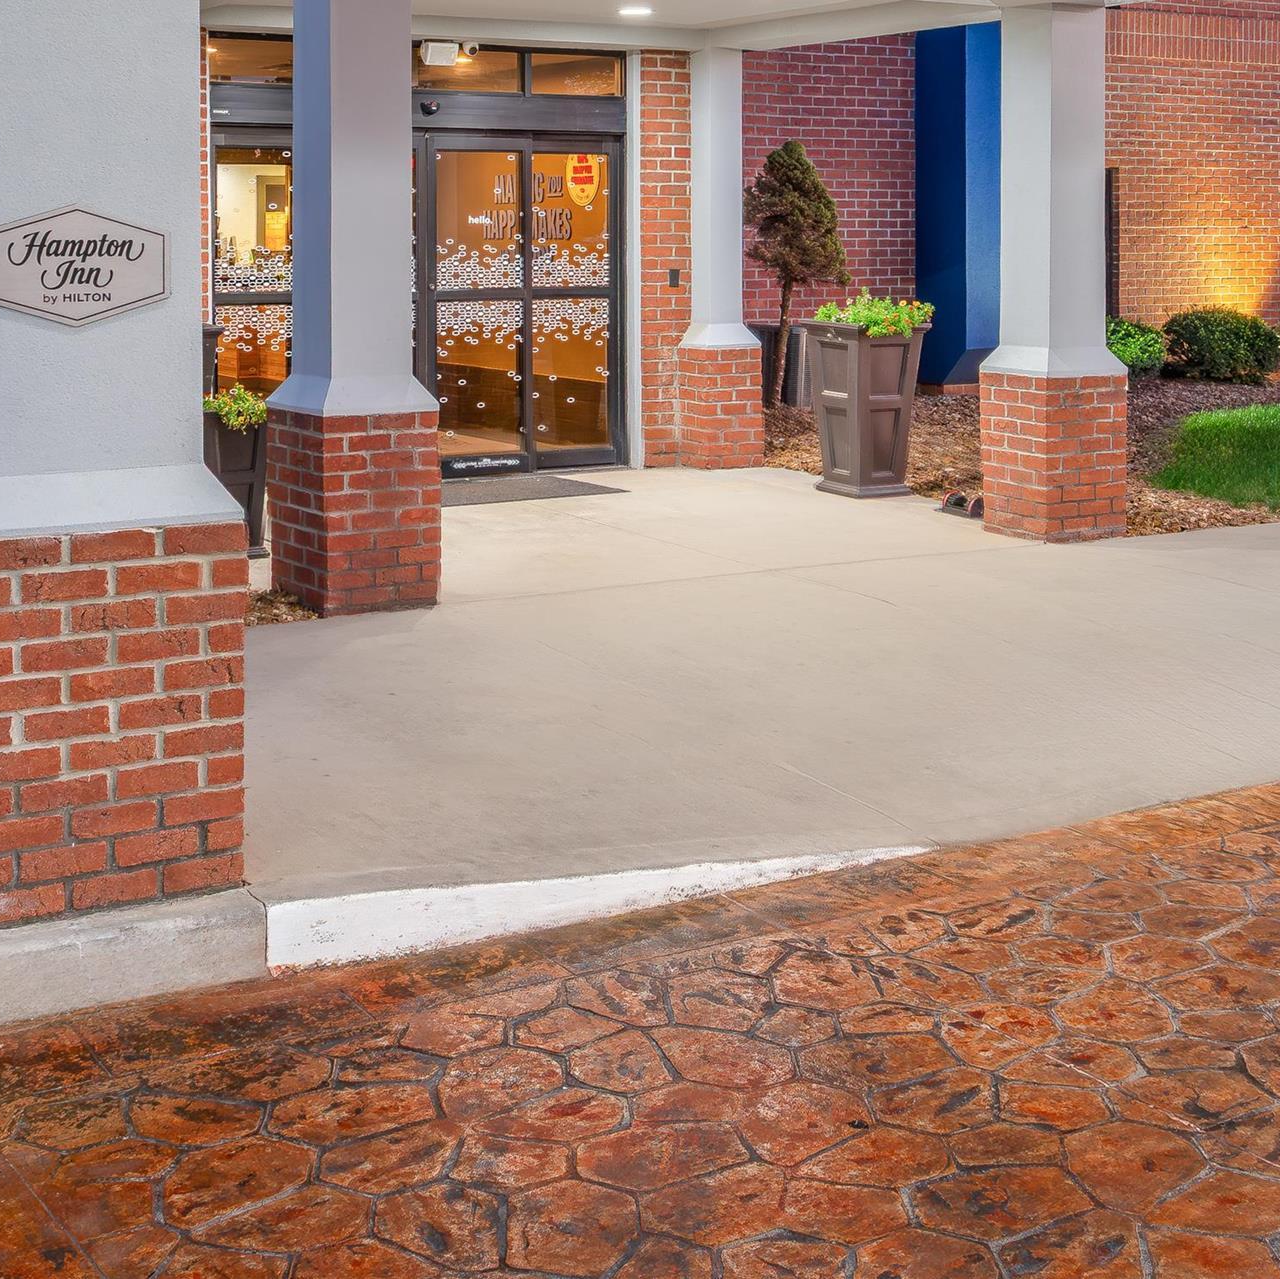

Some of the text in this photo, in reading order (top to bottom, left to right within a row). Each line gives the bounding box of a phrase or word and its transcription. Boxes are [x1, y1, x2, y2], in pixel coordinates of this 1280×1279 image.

[494, 173, 563, 204] MAG YOU
[468, 215, 493, 224] hello.
[482, 209, 517, 240] HAPP
[7, 230, 145, 266] Hampton
[40, 260, 114, 290] Inn
[42, 292, 112, 305] by HILTON
